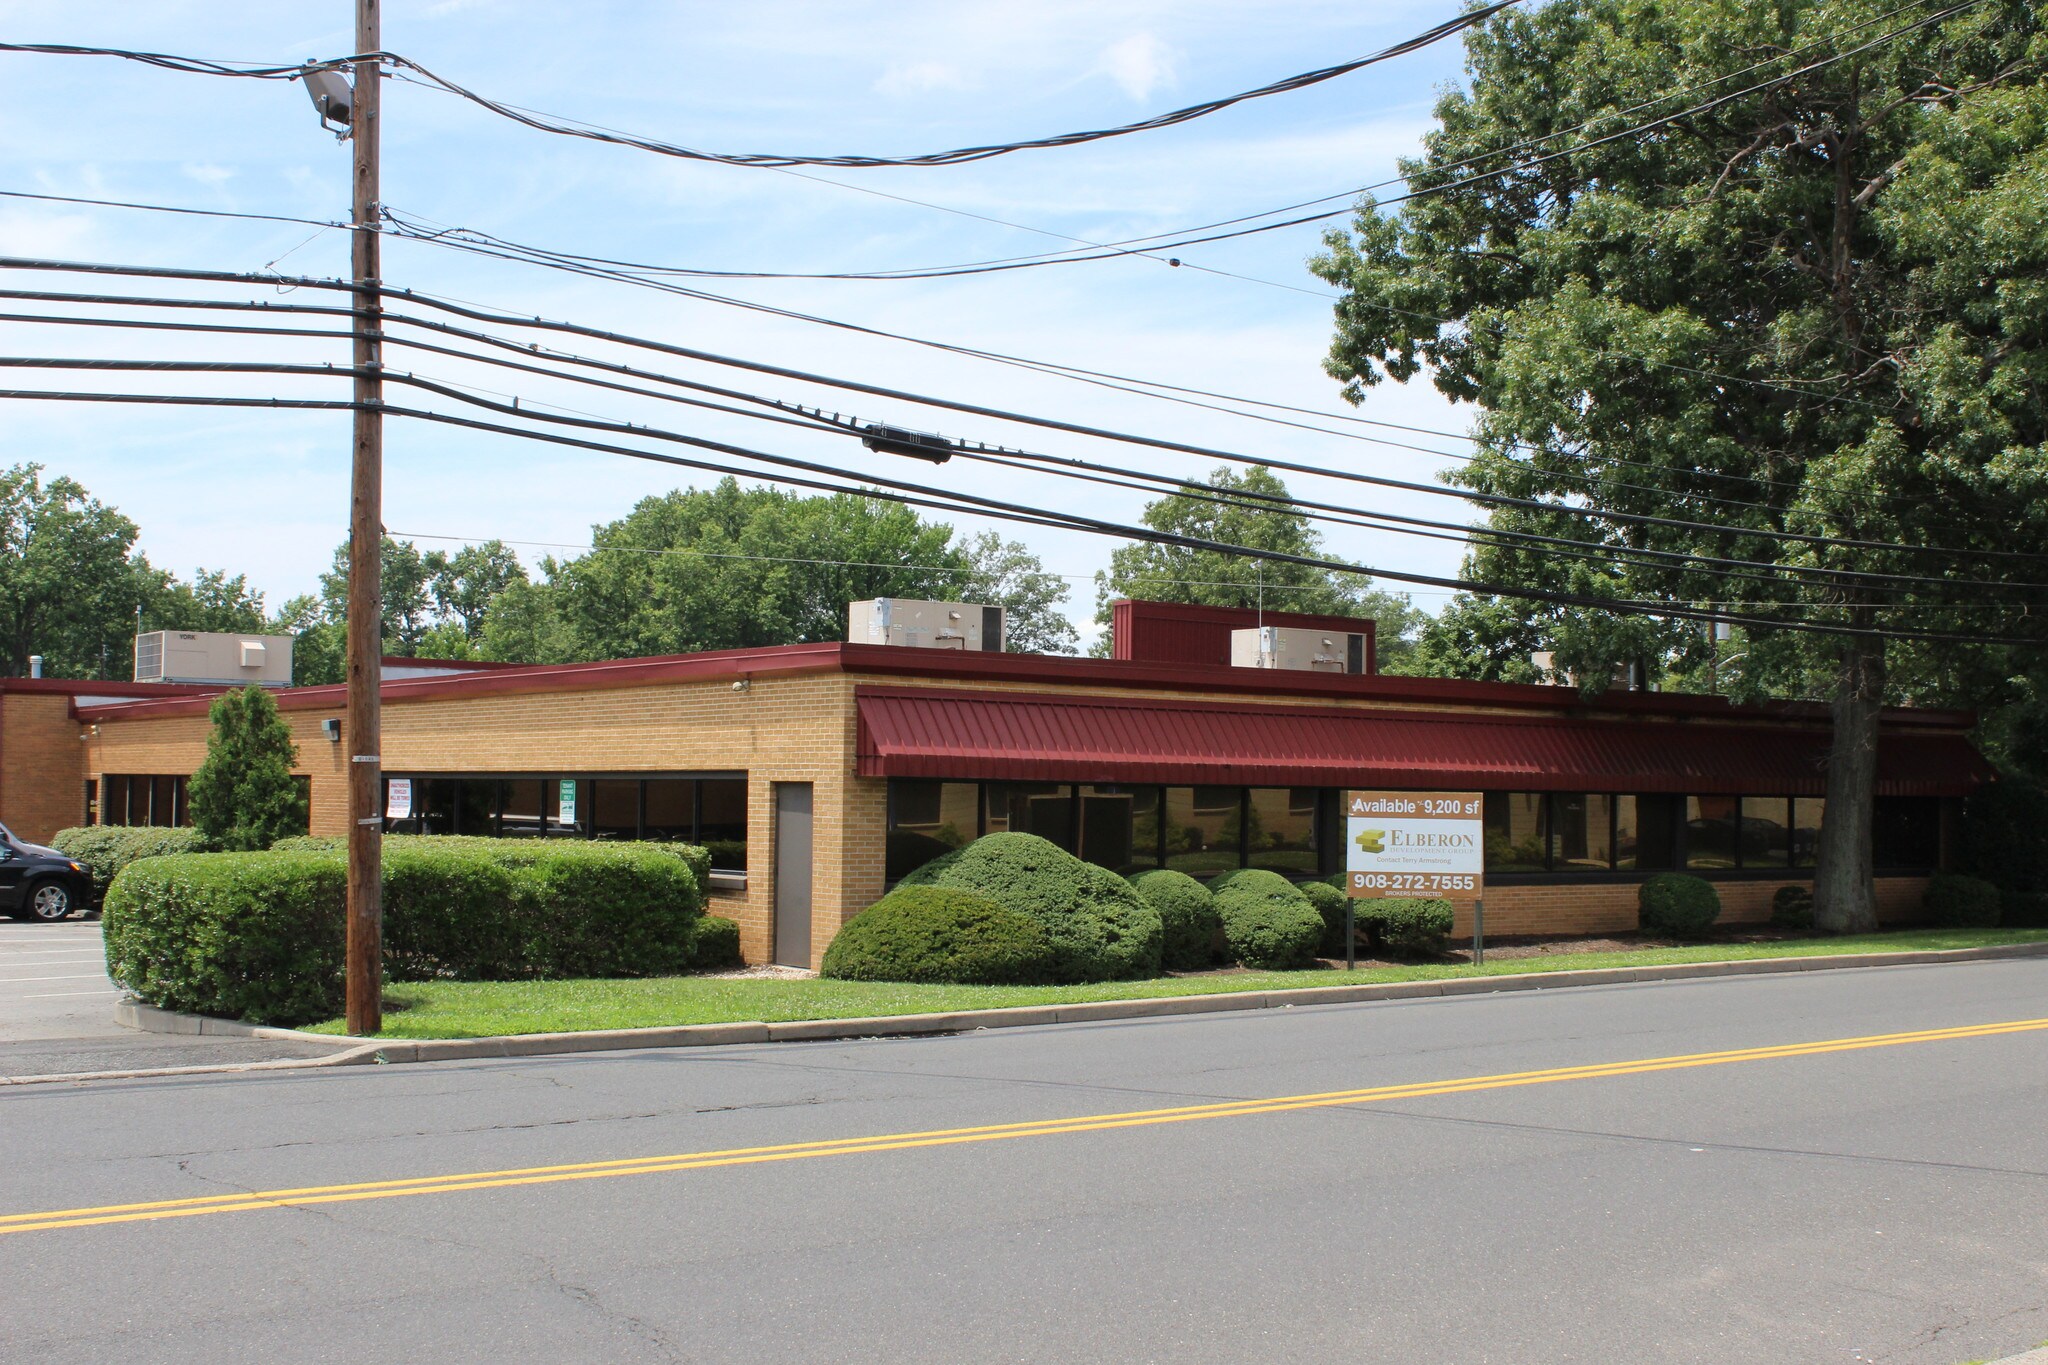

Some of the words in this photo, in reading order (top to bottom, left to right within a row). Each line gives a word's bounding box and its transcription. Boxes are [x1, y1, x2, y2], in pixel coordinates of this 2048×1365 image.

[1352, 798, 1416, 814] Available
[1465, 800, 1480, 815] sf
[1391, 829, 1474, 847] ELBERON
[1376, 856, 1400, 864] Contact
[1402, 857, 1417, 865] Terry
[1418, 857, 1452, 866] Armstrong
[1354, 874, 1474, 890] 908-272-7555
